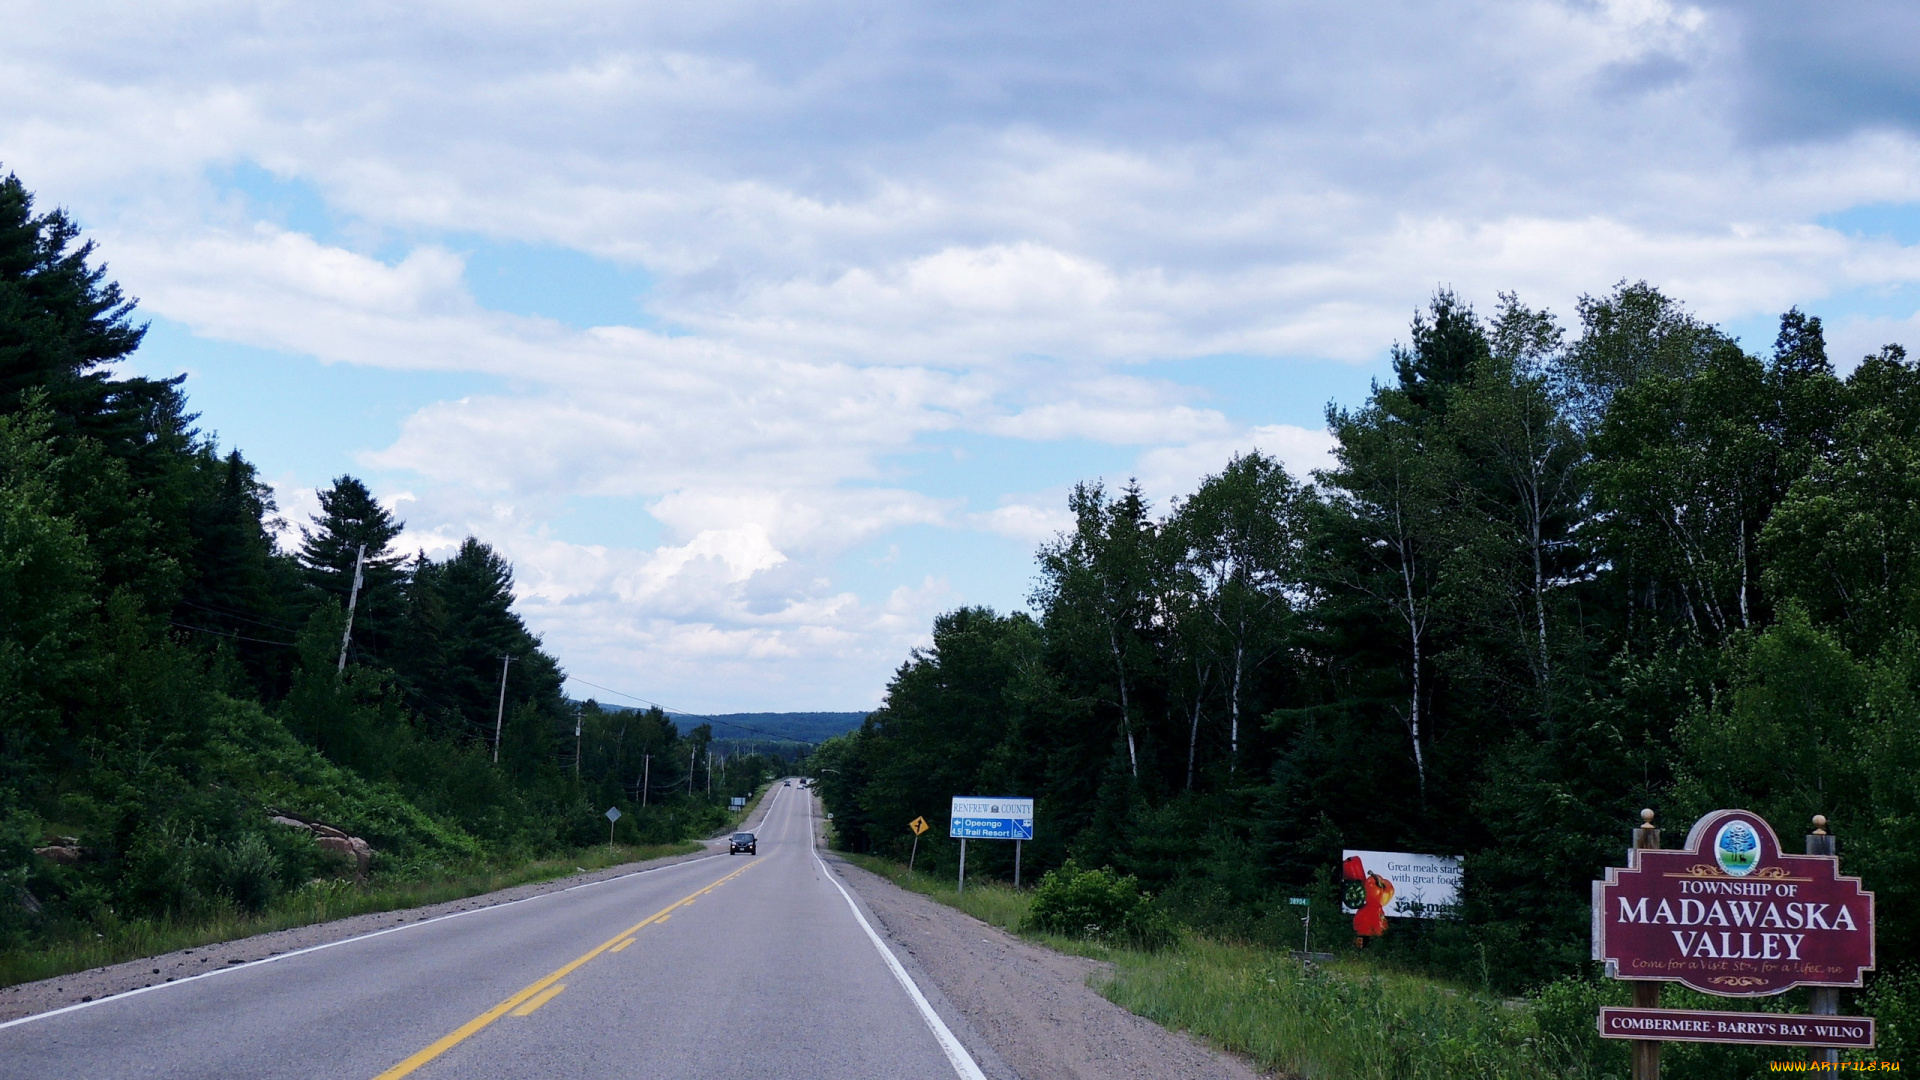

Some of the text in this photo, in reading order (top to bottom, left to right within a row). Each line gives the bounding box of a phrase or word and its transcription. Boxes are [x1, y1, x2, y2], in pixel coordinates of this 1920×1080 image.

[953, 803, 1031, 814] RENFREW COUNTY
[965, 819, 1002, 829] Opeongo
[951, 827, 962, 836] 4.5
[965, 828, 1010, 837] Trail Resort
[1387, 861, 1459, 875] Great meals start
[1391, 873, 1411, 883] with
[1412, 874, 1434, 886] great
[1679, 880, 1798, 898] TOWNSHIP OF
[1617, 896, 1858, 932] MADAWASKA
[1671, 930, 1806, 961] VALLEY
[1632, 958, 1665, 969] Come
[1667, 958, 1684, 974] for
[1794, 961, 1844, 975] Lifetme
[1611, 1016, 1864, 1039] COMBERMERE BARRY'S BAY WILNO
